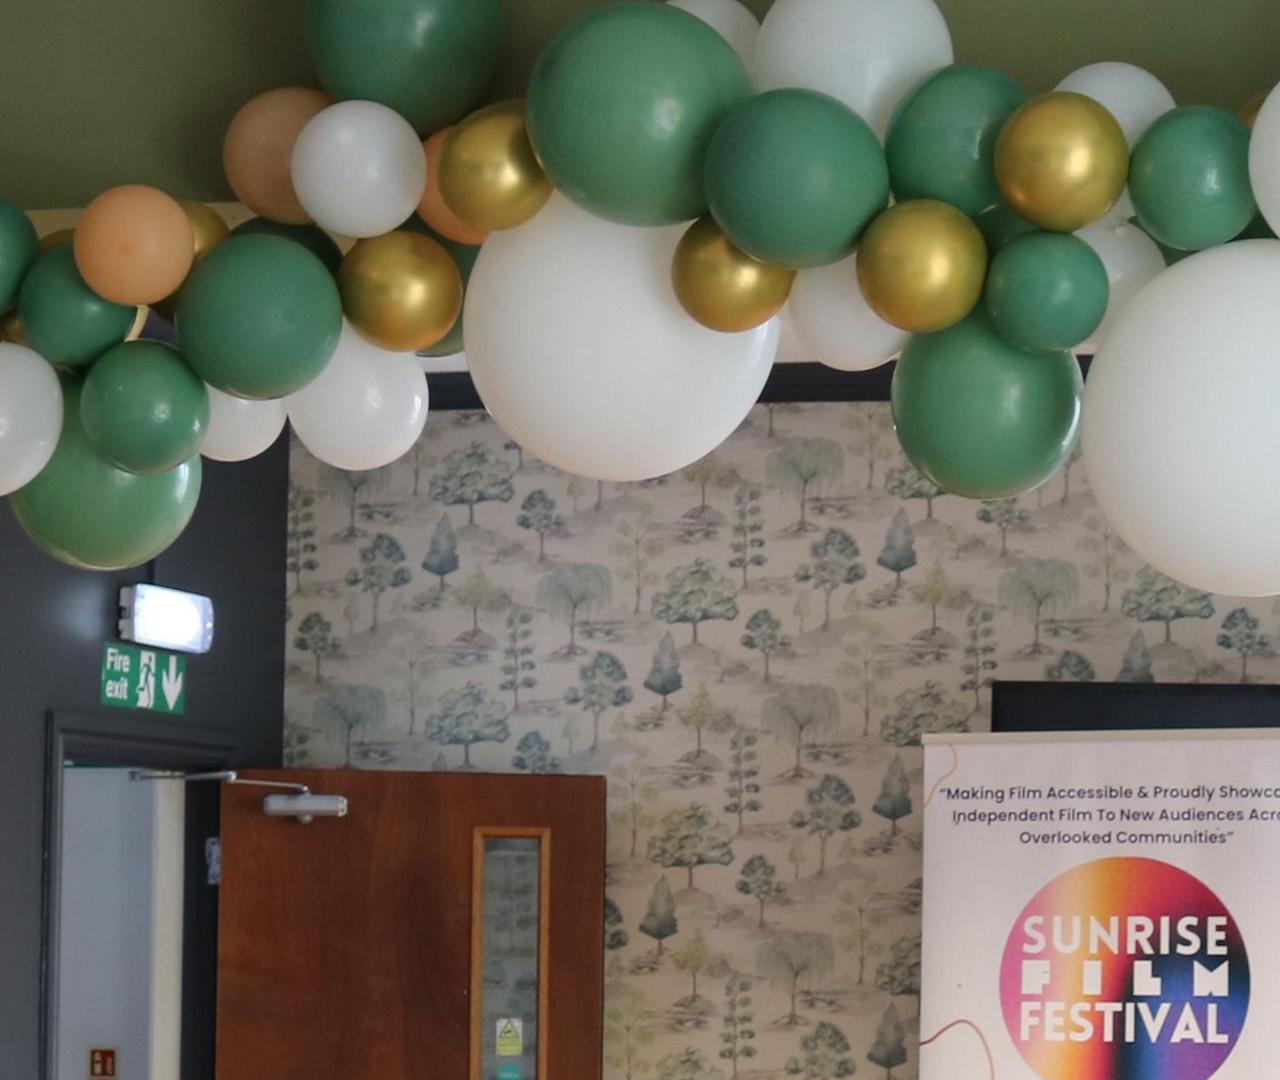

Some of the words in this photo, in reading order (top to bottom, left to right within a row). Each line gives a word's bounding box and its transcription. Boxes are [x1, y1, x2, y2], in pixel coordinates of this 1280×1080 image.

[107, 647, 130, 673] Fire
[106, 676, 128, 700] exit
[1009, 786, 1042, 799] Film
[1047, 785, 1132, 799] Accessible
[1137, 786, 1149, 799] &
[1154, 785, 1215, 802] Proudly
[952, 808, 1055, 826] Independent
[1059, 808, 1092, 822] Film
[1097, 808, 1116, 822] To
[1120, 808, 1155, 822] New
[1158, 808, 1244, 822] Audiences
[1019, 830, 1112, 844] Overlooked
[1022, 914, 1229, 955] SUNRISE
[1021, 959, 1229, 997] FILM
[1020, 1002, 1229, 1044] FESTIVAL
